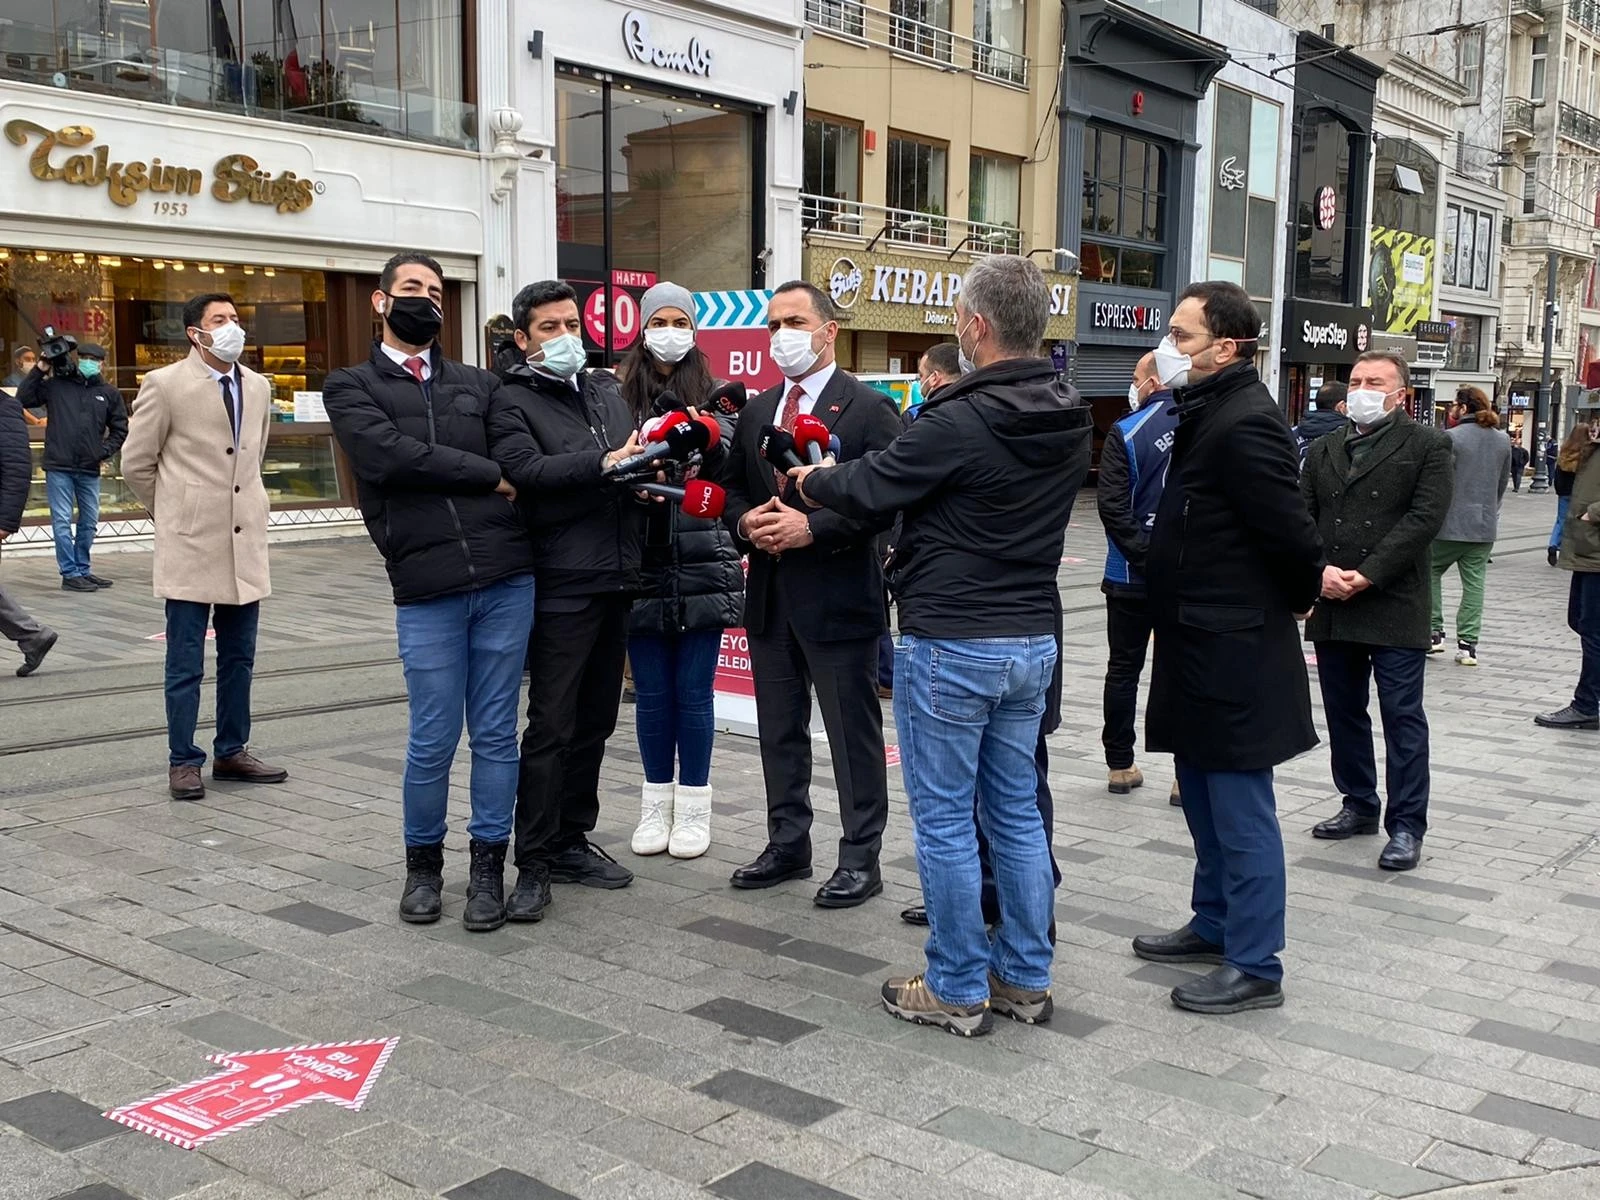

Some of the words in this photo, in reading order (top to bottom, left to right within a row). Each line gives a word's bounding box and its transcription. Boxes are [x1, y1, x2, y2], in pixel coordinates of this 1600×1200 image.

[621, 10, 712, 78] Bambi
[4, 118, 203, 208] Taksim
[153, 202, 188, 217] 1953
[615, 271, 648, 287] HAFTA
[1302, 319, 1348, 351] SuperStep
[729, 350, 762, 376] BU
[283, 1052, 360, 1082] YÖNDEN
[326, 1051, 360, 1065] BU
